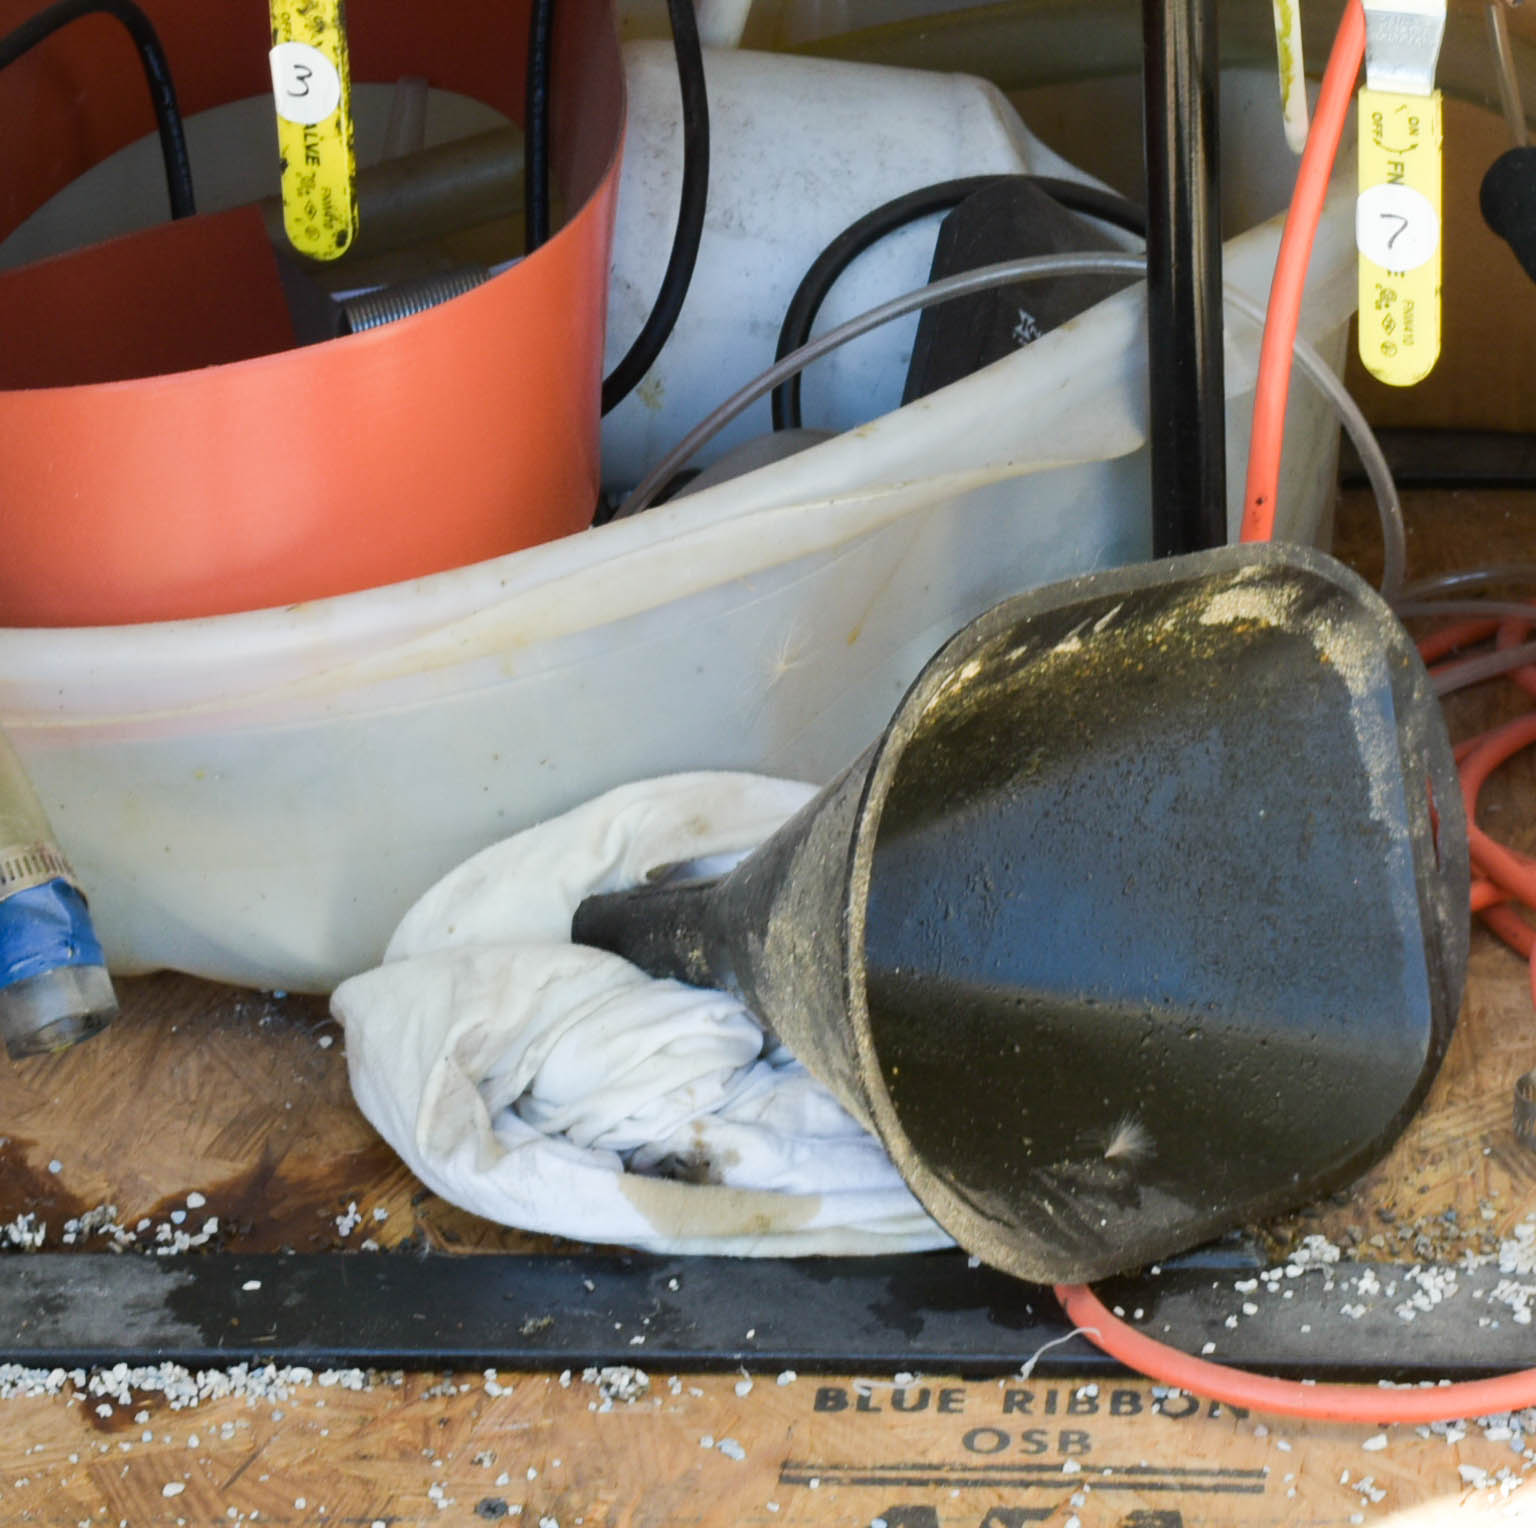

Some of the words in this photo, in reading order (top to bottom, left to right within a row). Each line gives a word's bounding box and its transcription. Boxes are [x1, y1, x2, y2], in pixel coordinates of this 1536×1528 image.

[284, 63, 314, 99] 3
[1369, 111, 1383, 145] OFF
[1406, 115, 1421, 137] ON
[1385, 159, 1406, 186] FN
[1379, 212, 1410, 251] 7
[813, 1385, 964, 1415] BLUE
[1001, 1384, 1251, 1421] RIBBON
[963, 1426, 1094, 1458] OSB
